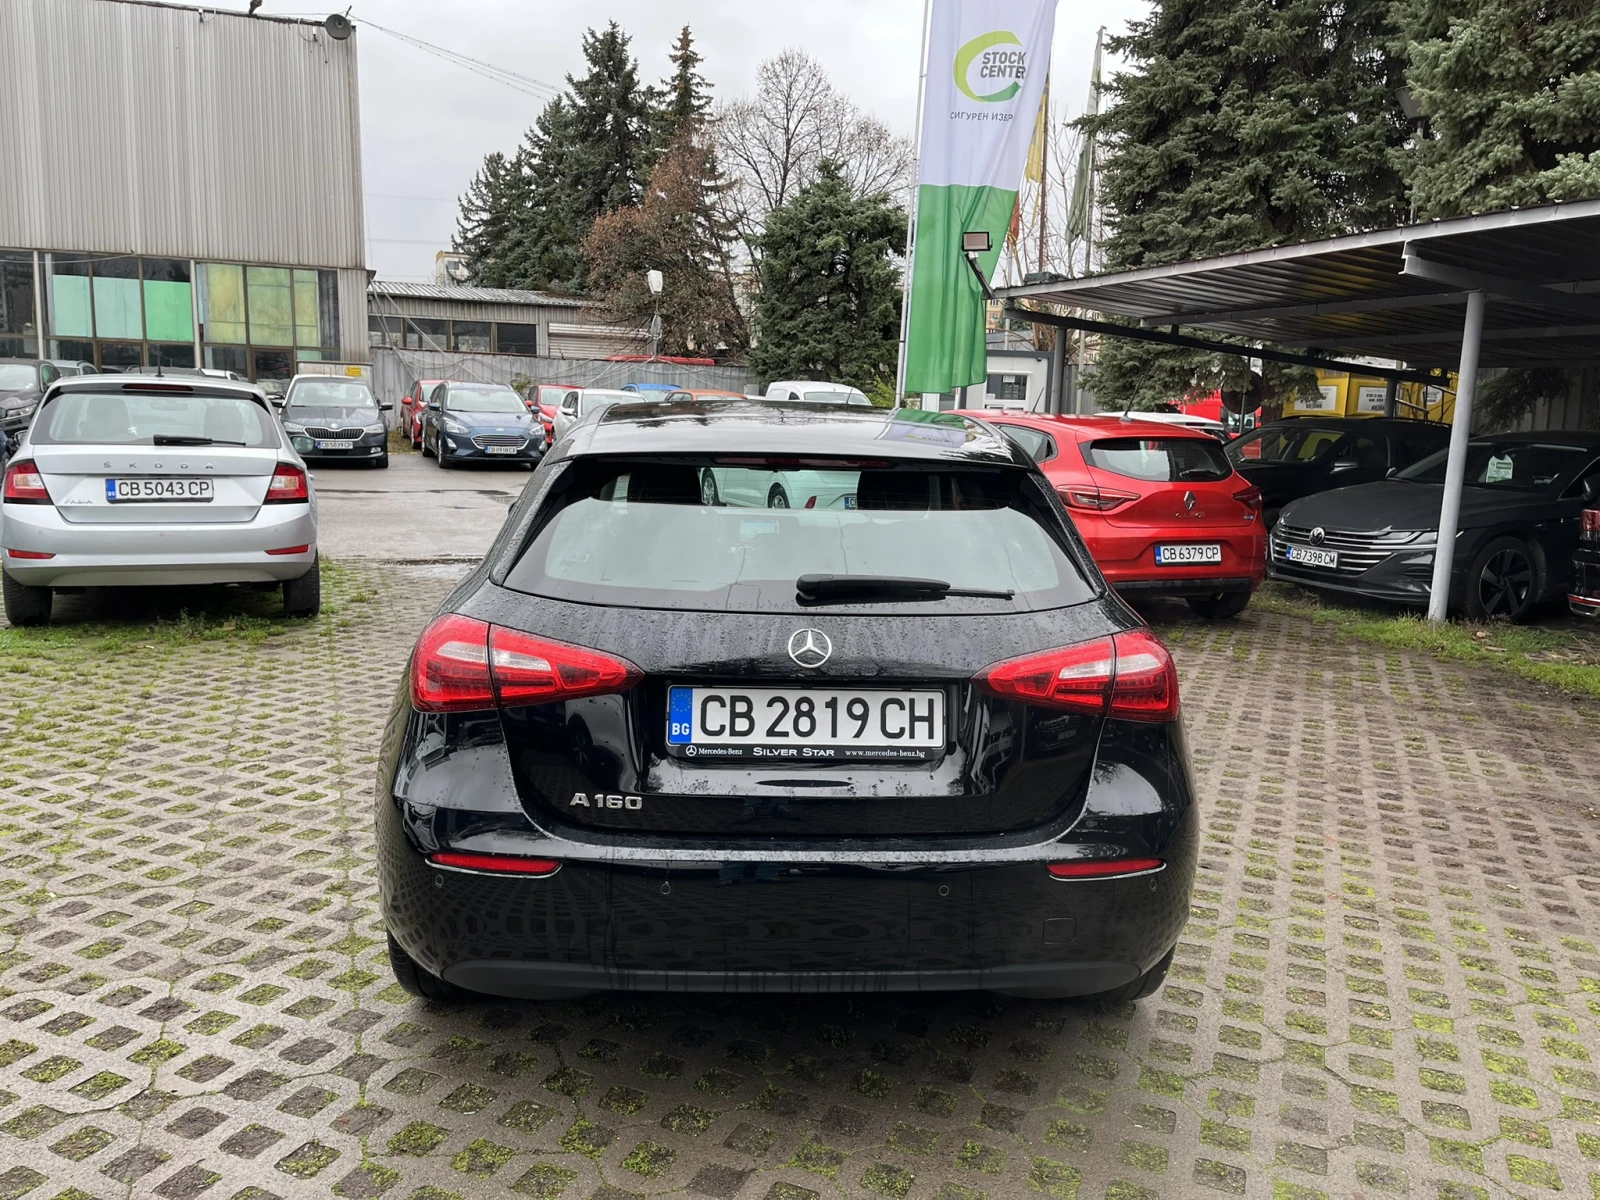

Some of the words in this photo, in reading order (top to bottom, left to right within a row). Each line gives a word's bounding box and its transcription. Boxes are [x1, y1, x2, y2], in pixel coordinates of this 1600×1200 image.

[982, 52, 1027, 65] STOCK
[980, 65, 1026, 79] CENTER
[950, 111, 988, 121] СИГУРЕН
[118, 481, 141, 496] CB
[144, 481, 185, 496] 5043
[188, 481, 210, 496] CP
[1162, 548, 1177, 560] CB
[1179, 547, 1203, 560] 6379
[1205, 547, 1219, 560] CP
[1292, 548, 1302, 560] CB
[1302, 550, 1323, 563] 7398
[1324, 553, 1336, 565] CM
[671, 722, 690, 735] BG
[700, 694, 755, 737] CB
[766, 696, 869, 738] 2819
[880, 697, 934, 739] CH
[699, 747, 743, 756] Mercedes-Benz
[752, 747, 797, 757] SILVER
[802, 747, 835, 757] STAR
[845, 749, 926, 759] www.mercedes-benz.bg
[569, 792, 590, 807] A
[594, 794, 643, 810] 160
